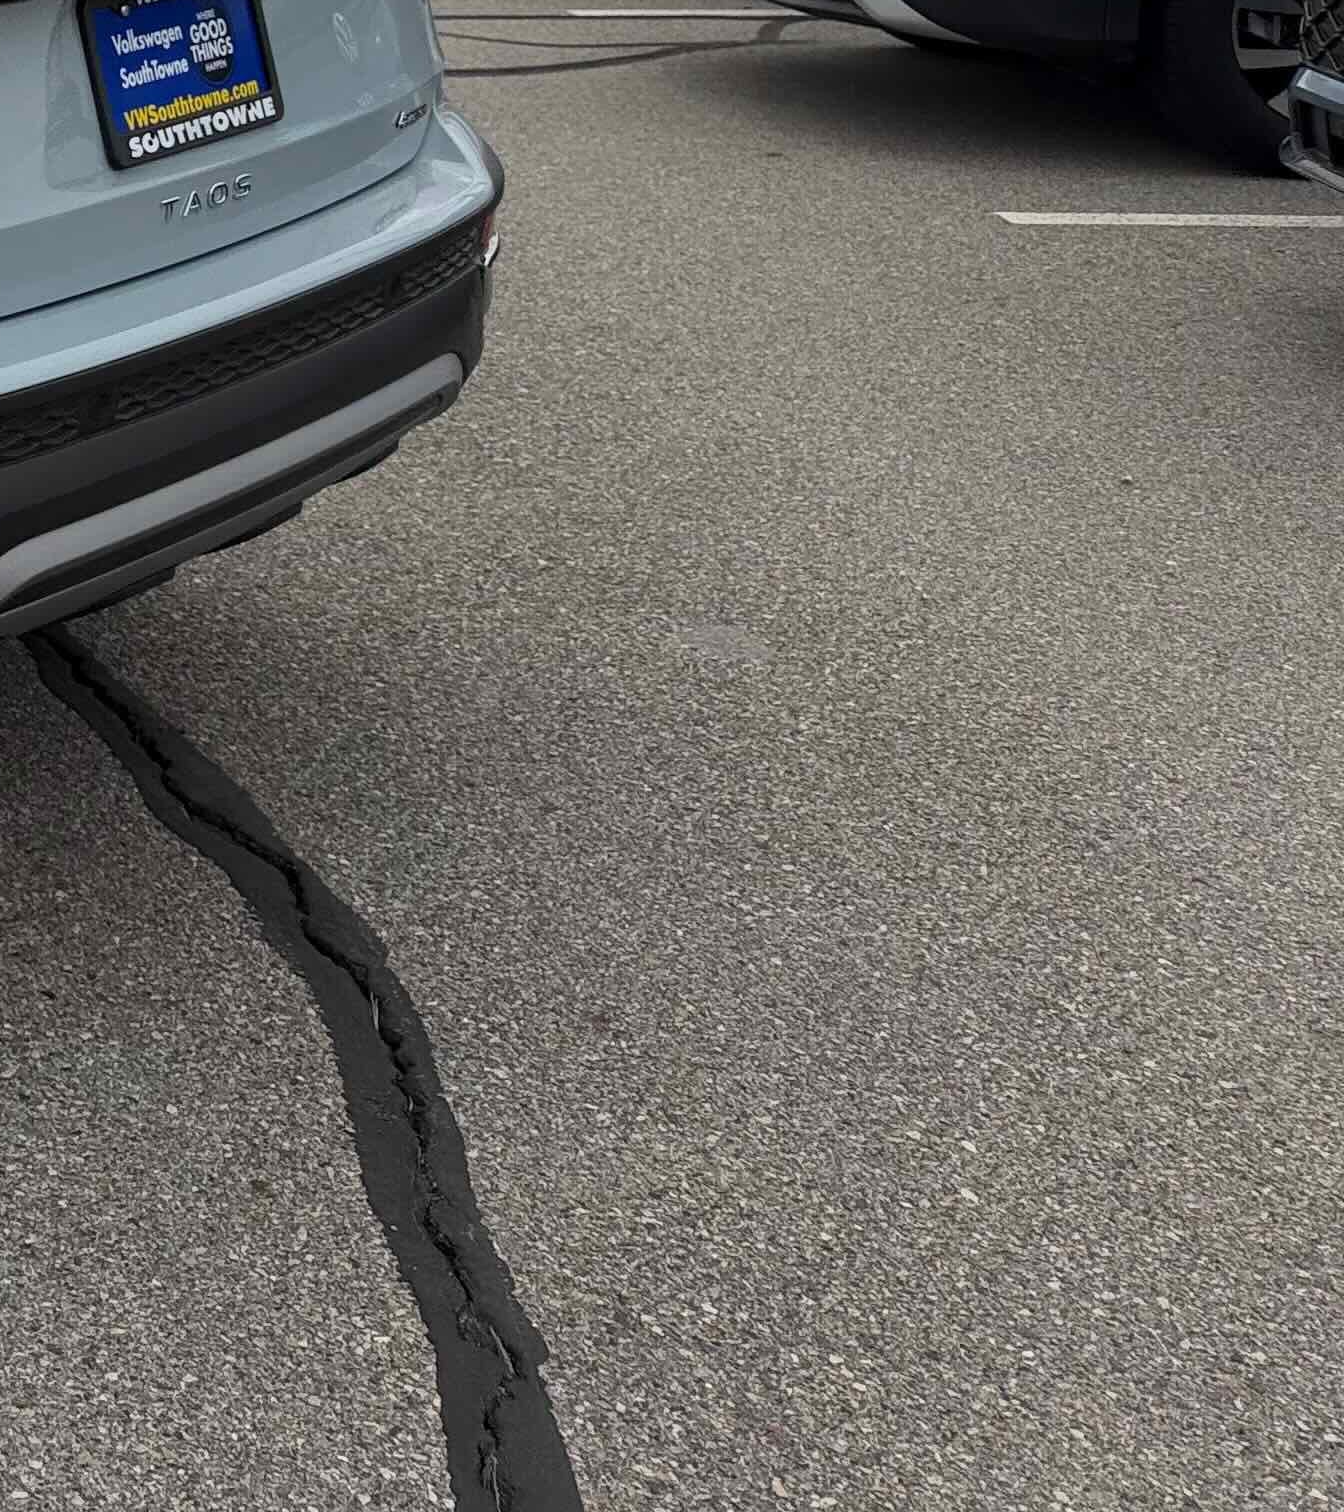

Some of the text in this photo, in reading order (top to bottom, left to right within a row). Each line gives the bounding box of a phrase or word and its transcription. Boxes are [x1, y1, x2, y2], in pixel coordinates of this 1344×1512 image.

[111, 25, 183, 56] Volkswagen
[190, 18, 227, 44] GOOD
[190, 36, 234, 63] THINGS
[120, 58, 189, 89] SouthTowne
[124, 80, 260, 130] VWSouthtowne.com
[128, 96, 277, 159] SOUTHTOWNE
[160, 173, 253, 222] TAOS
